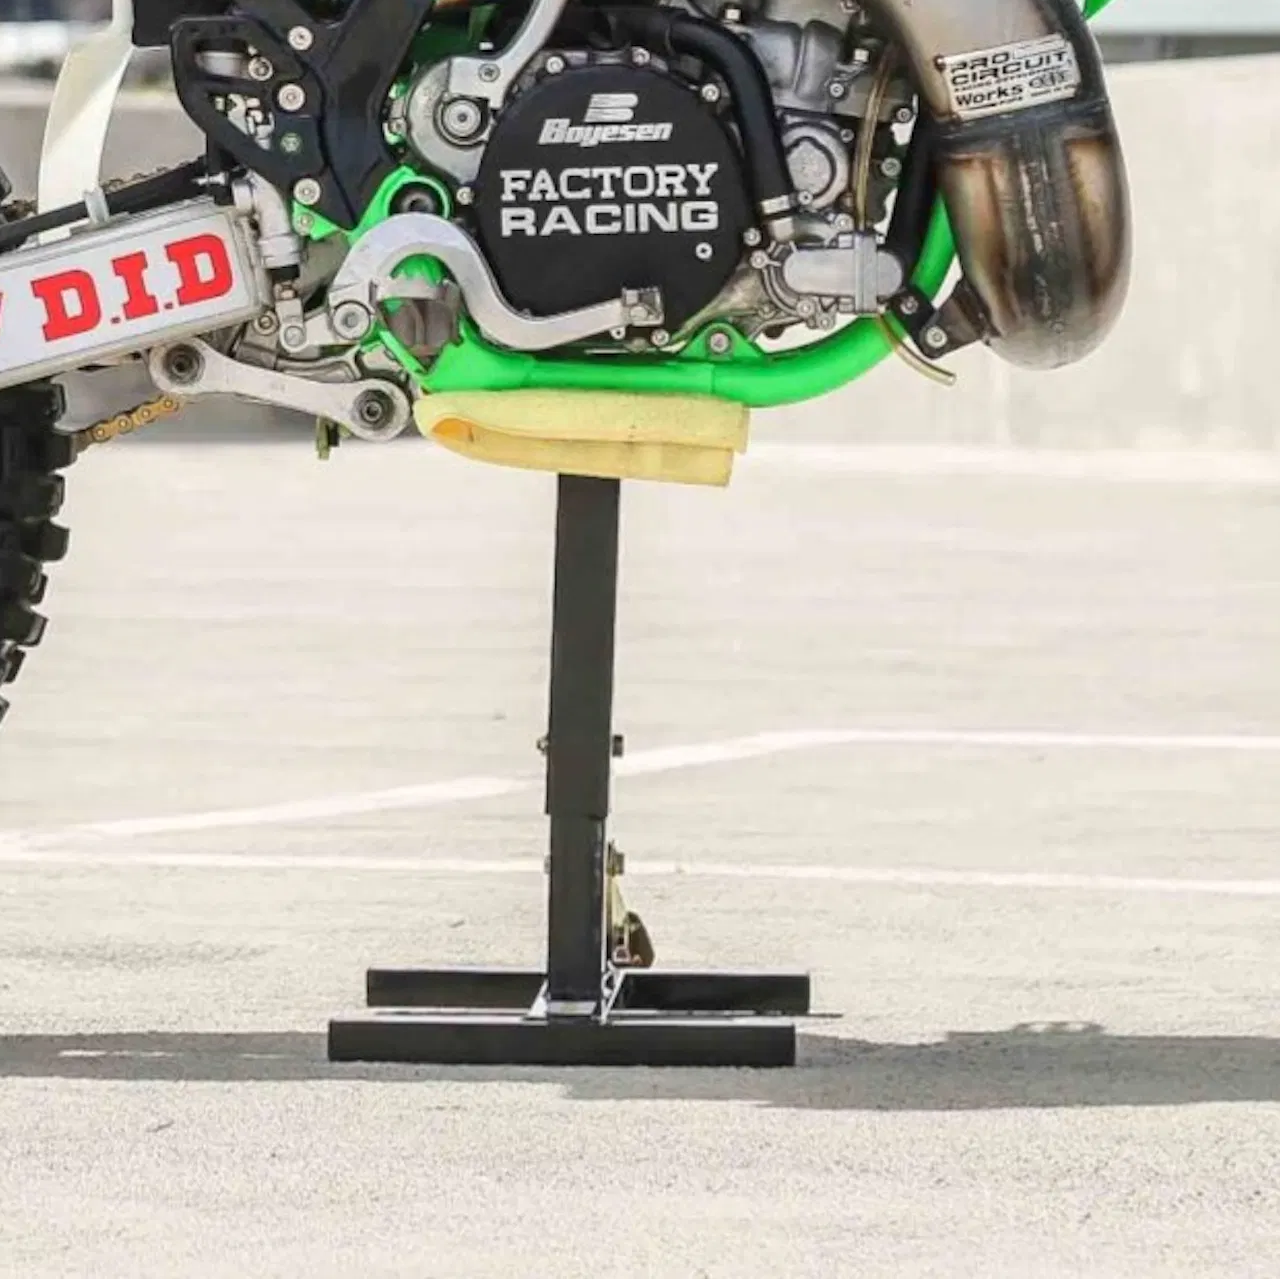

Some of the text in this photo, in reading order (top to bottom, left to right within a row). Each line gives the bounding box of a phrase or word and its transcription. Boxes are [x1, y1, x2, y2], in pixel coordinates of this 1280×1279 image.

[951, 52, 1010, 74] PRO
[951, 51, 1068, 86] CIRCUIT
[955, 85, 1023, 106] Works
[538, 118, 673, 147] Boyesen
[500, 163, 718, 202] FACTORY
[501, 201, 719, 236] RACING
[31, 233, 234, 342] D.I.D
